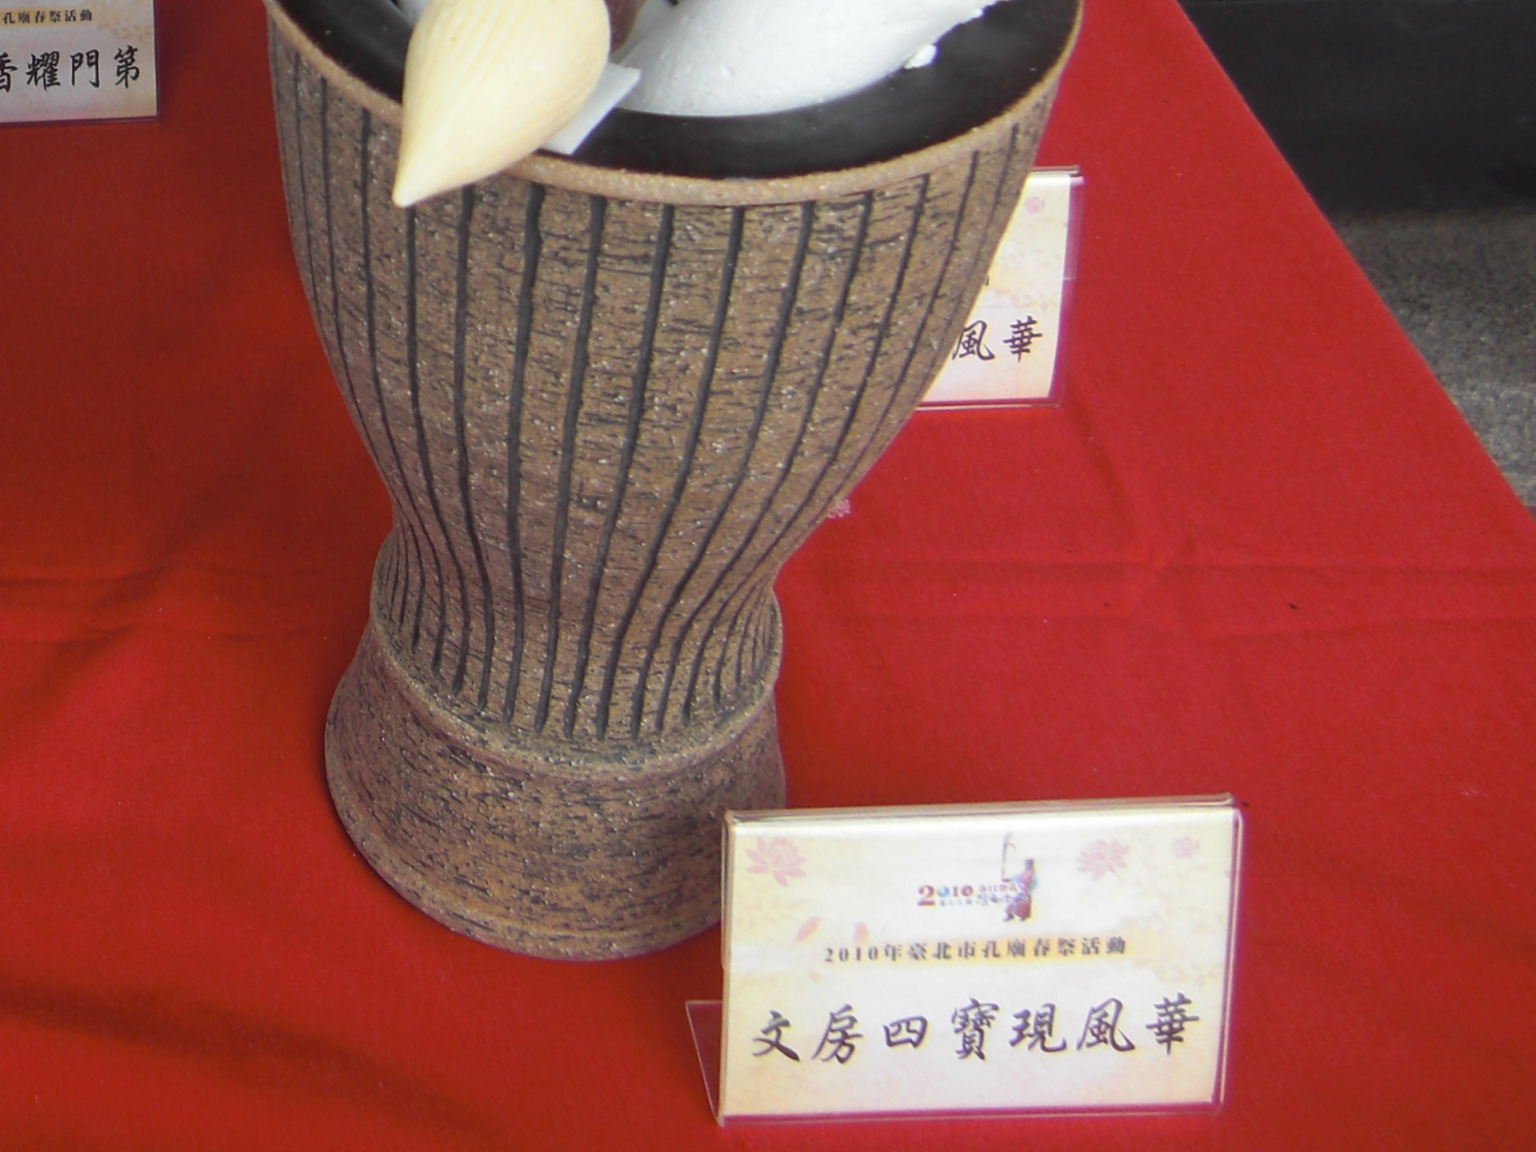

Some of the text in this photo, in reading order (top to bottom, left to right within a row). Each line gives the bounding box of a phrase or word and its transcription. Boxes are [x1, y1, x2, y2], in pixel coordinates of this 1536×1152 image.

[951, 315, 1043, 363] 風華
[824, 936, 1128, 963] 2010年臺北市孔廟春祭活動
[752, 992, 1200, 1064] 文房四寶現風華
